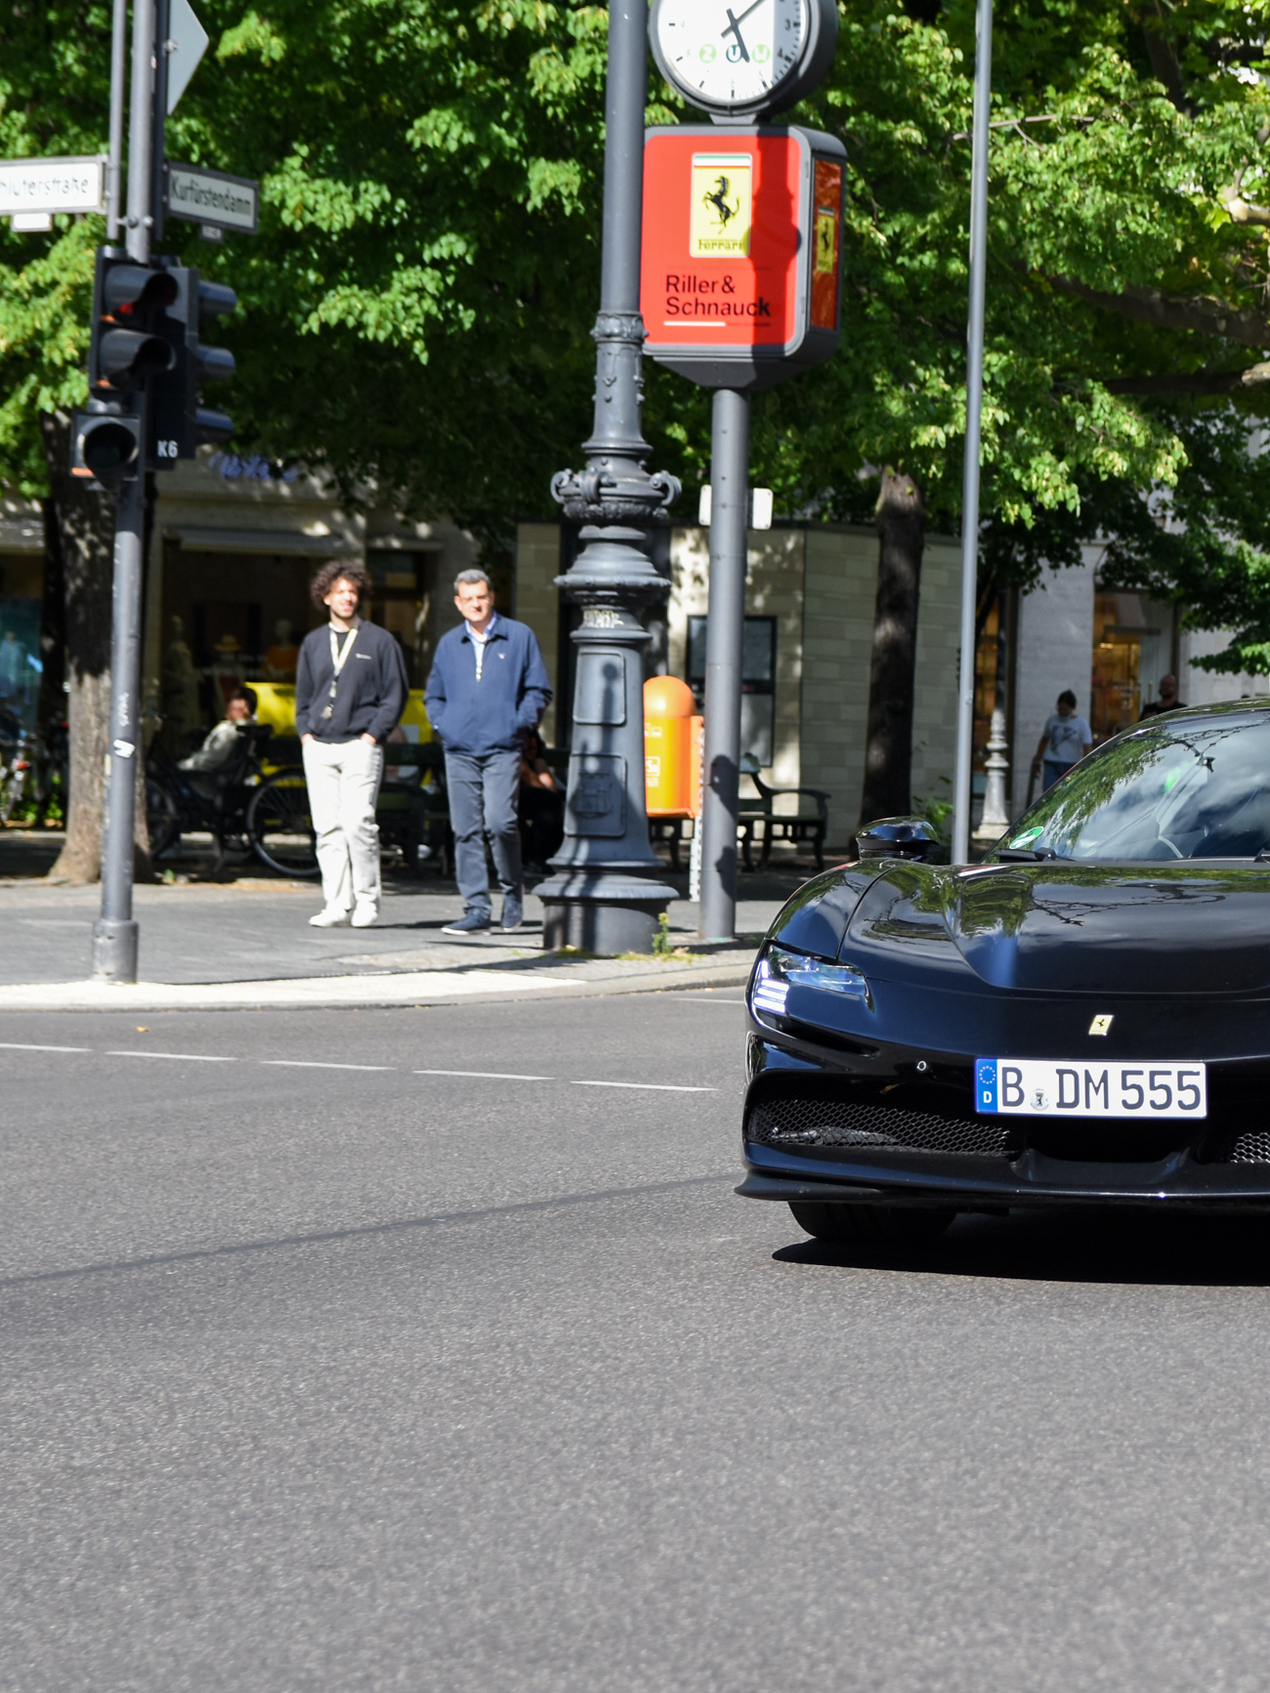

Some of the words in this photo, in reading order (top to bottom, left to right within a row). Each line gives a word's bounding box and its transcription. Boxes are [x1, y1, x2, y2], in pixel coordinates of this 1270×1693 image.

[171, 176, 252, 215] Kurfürstendamm
[698, 238, 743, 251] Ferrari
[666, 275, 719, 294] Riller
[666, 296, 771, 317] Schnauck
[157, 439, 179, 458] K6
[983, 1091, 992, 1103] D
[1002, 1066, 1025, 1107] B
[1056, 1069, 1109, 1109] DM
[1121, 1070, 1201, 1110] 555
